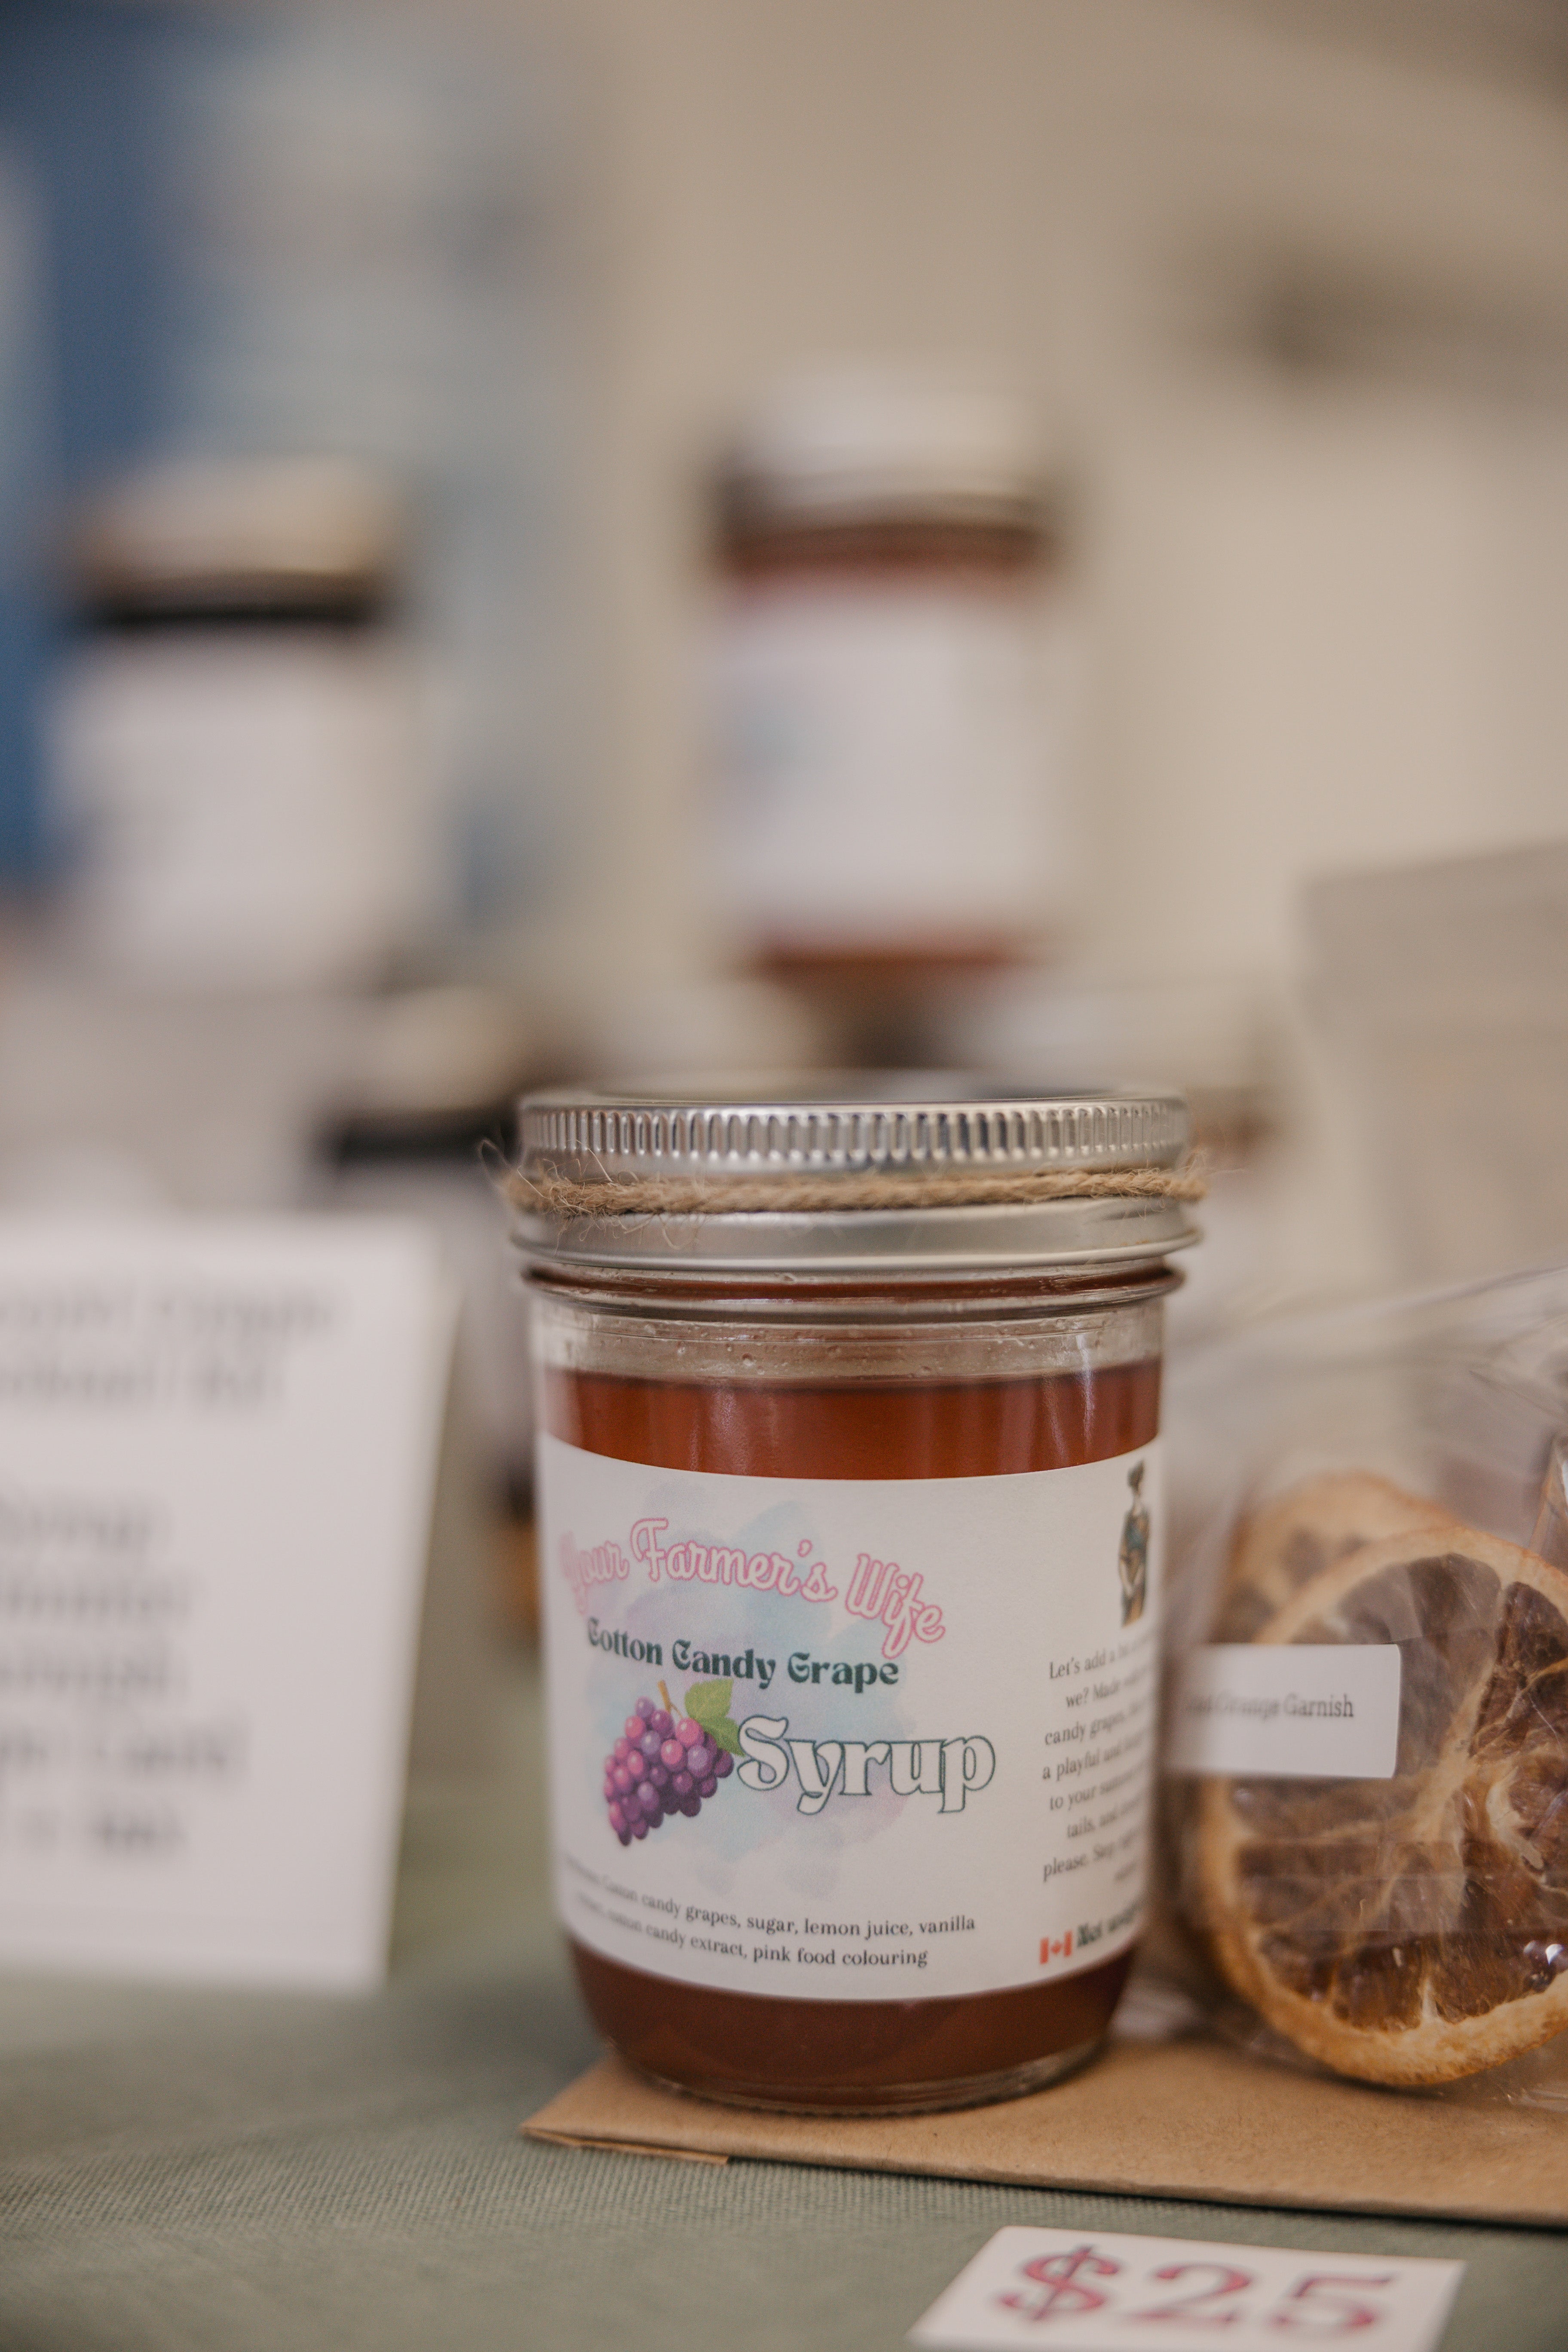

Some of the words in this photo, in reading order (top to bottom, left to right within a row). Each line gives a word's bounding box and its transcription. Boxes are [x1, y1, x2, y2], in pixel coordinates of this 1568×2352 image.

[630, 1518, 837, 1602] Farmer's
[845, 1553, 945, 1659] Wife
[588, 1616, 663, 1666] Cotton
[672, 1639, 776, 1689] Candy
[787, 1652, 899, 1694] Grape
[1049, 1656, 1080, 1680] Let's
[1084, 1647, 1106, 1672] add
[1066, 1686, 1090, 1709] we?
[1283, 1693, 1354, 1718] Garnish
[1044, 1720, 1086, 1746] candy
[737, 1714, 996, 1815] Syrup
[1041, 1765, 1051, 1780] a
[1056, 1747, 1100, 1782] playful
[1049, 1795, 1064, 1811] to
[1068, 1784, 1097, 1810] your
[641, 1893, 682, 1919] candy
[685, 1905, 741, 1928] grapes,
[747, 1916, 798, 1935] sugar,
[804, 1917, 860, 1936] lemon
[864, 1920, 913, 1940] juice,
[918, 1914, 976, 1934] vanilla
[646, 1923, 687, 1949] candy
[690, 1934, 748, 1959] extract,
[753, 1944, 791, 1963] pink
[797, 1947, 836, 1965] food
[842, 1949, 928, 1969] colouring
[992, 2245, 1395, 2338] $25
